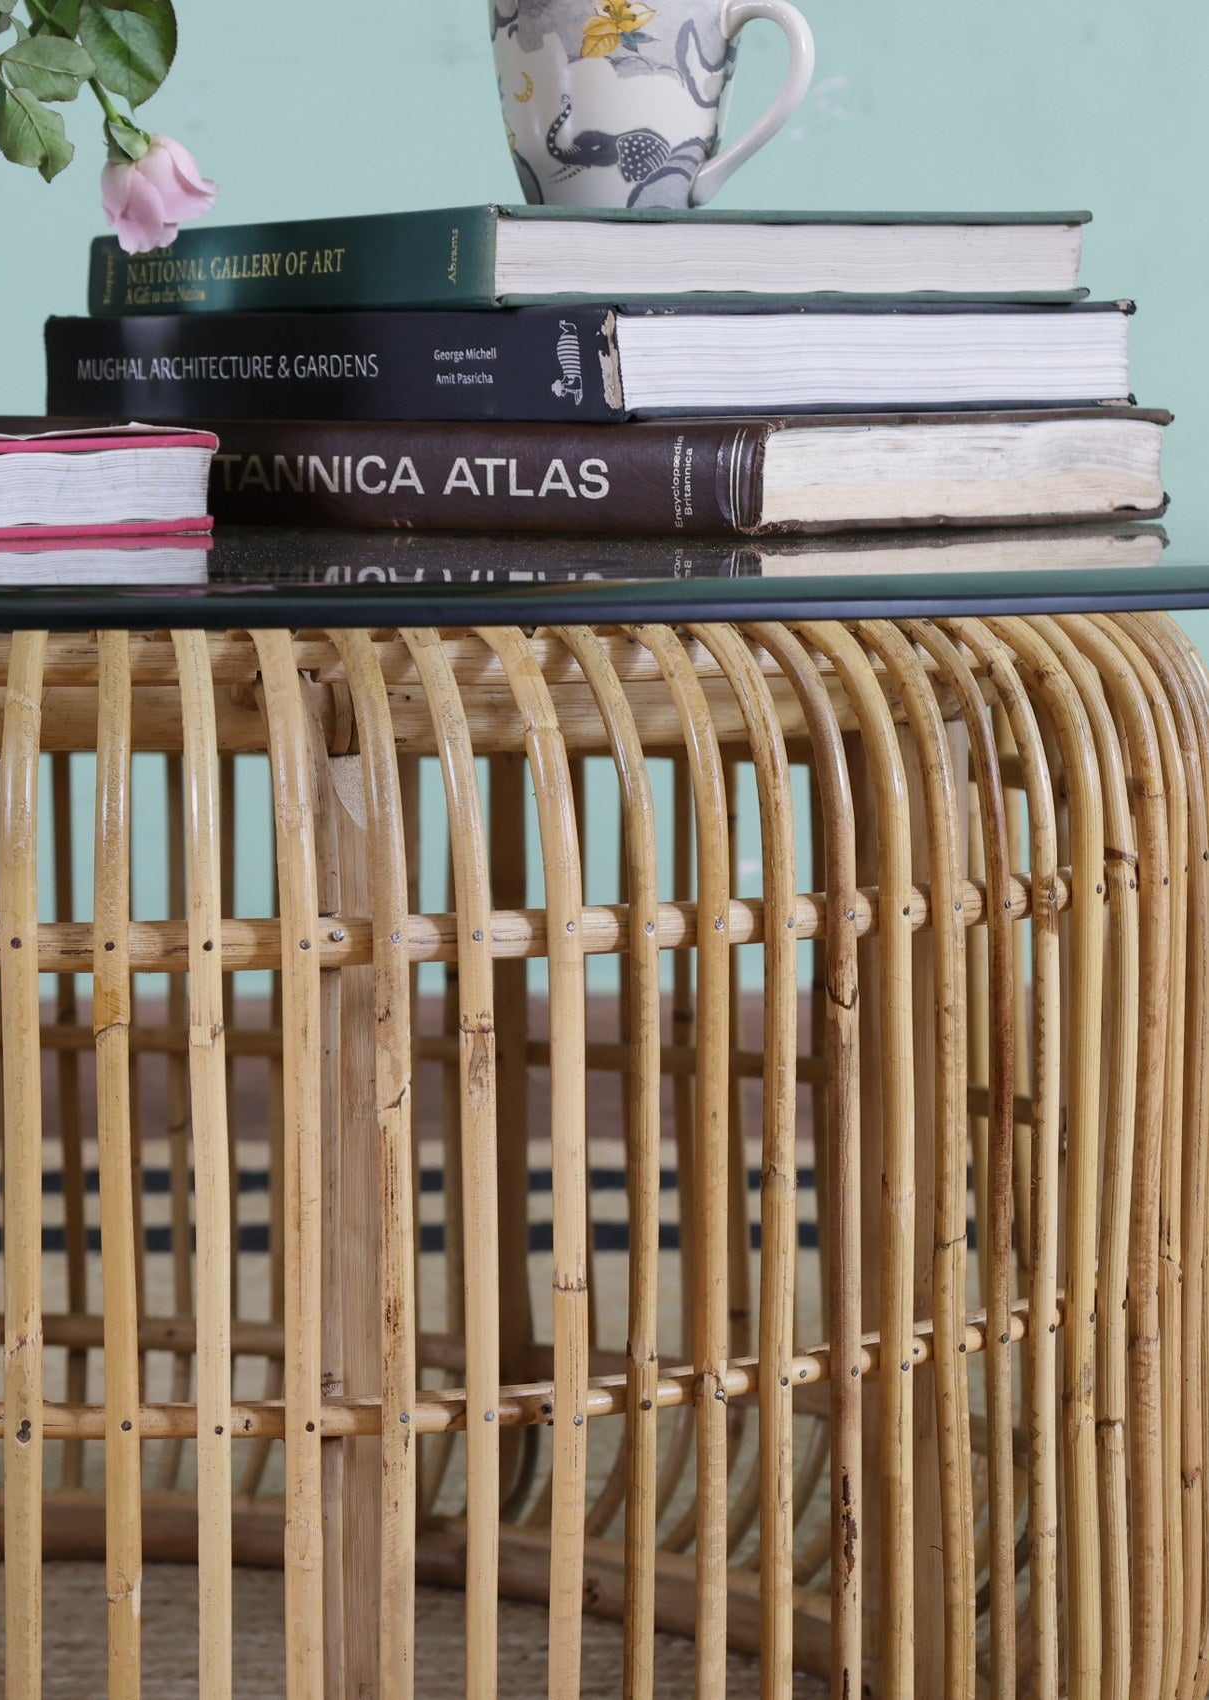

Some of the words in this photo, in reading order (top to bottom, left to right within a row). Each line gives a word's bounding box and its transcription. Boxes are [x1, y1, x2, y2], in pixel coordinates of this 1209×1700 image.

[127, 258, 207, 284] NATIONAL
[211, 253, 282, 280] GALLERY
[285, 251, 309, 276] OF
[311, 248, 346, 274] ART
[447, 228, 459, 284] Abrams
[77, 358, 146, 381] MUGHAL
[149, 355, 274, 380] ARCHITECTURE
[277, 355, 291, 378] &
[293, 353, 379, 379] GARDENS
[433, 349, 464, 363] George
[465, 347, 497, 360] Michell
[435, 373, 456, 384] Amit
[457, 372, 493, 384] Pasricha
[212, 454, 425, 495] TANNICA
[442, 457, 610, 499] ATLAS
[683, 448, 693, 516] Britannica
